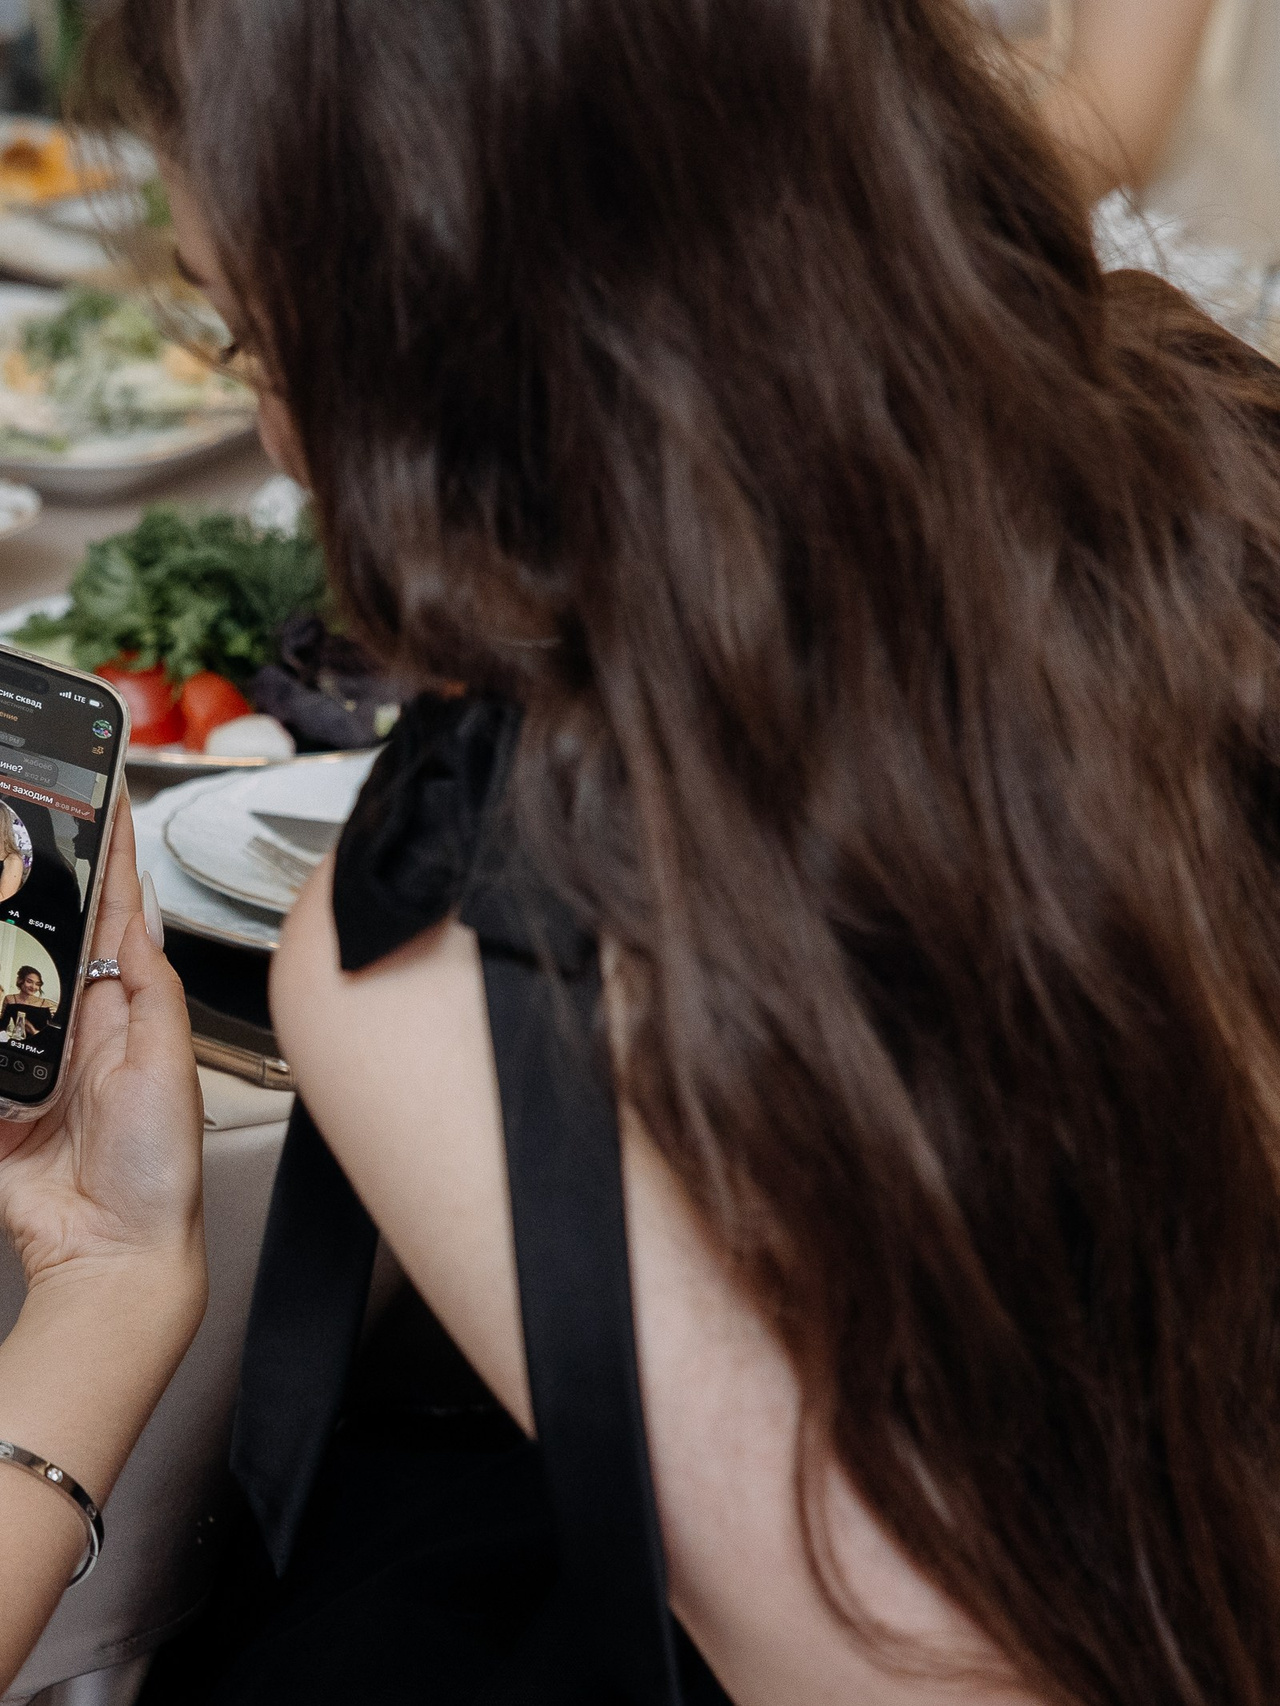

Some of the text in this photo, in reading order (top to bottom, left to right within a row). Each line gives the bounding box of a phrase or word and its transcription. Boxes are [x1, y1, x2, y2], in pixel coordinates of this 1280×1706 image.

[15, 695, 42, 709] сквад
[74, 694, 86, 704] LTE
[12, 785, 54, 804] заходим
[55, 801, 82, 815] 8:08 PM
[28, 918, 56, 932] 8:50 PM
[10, 1040, 37, 1054] 9:31 PM
